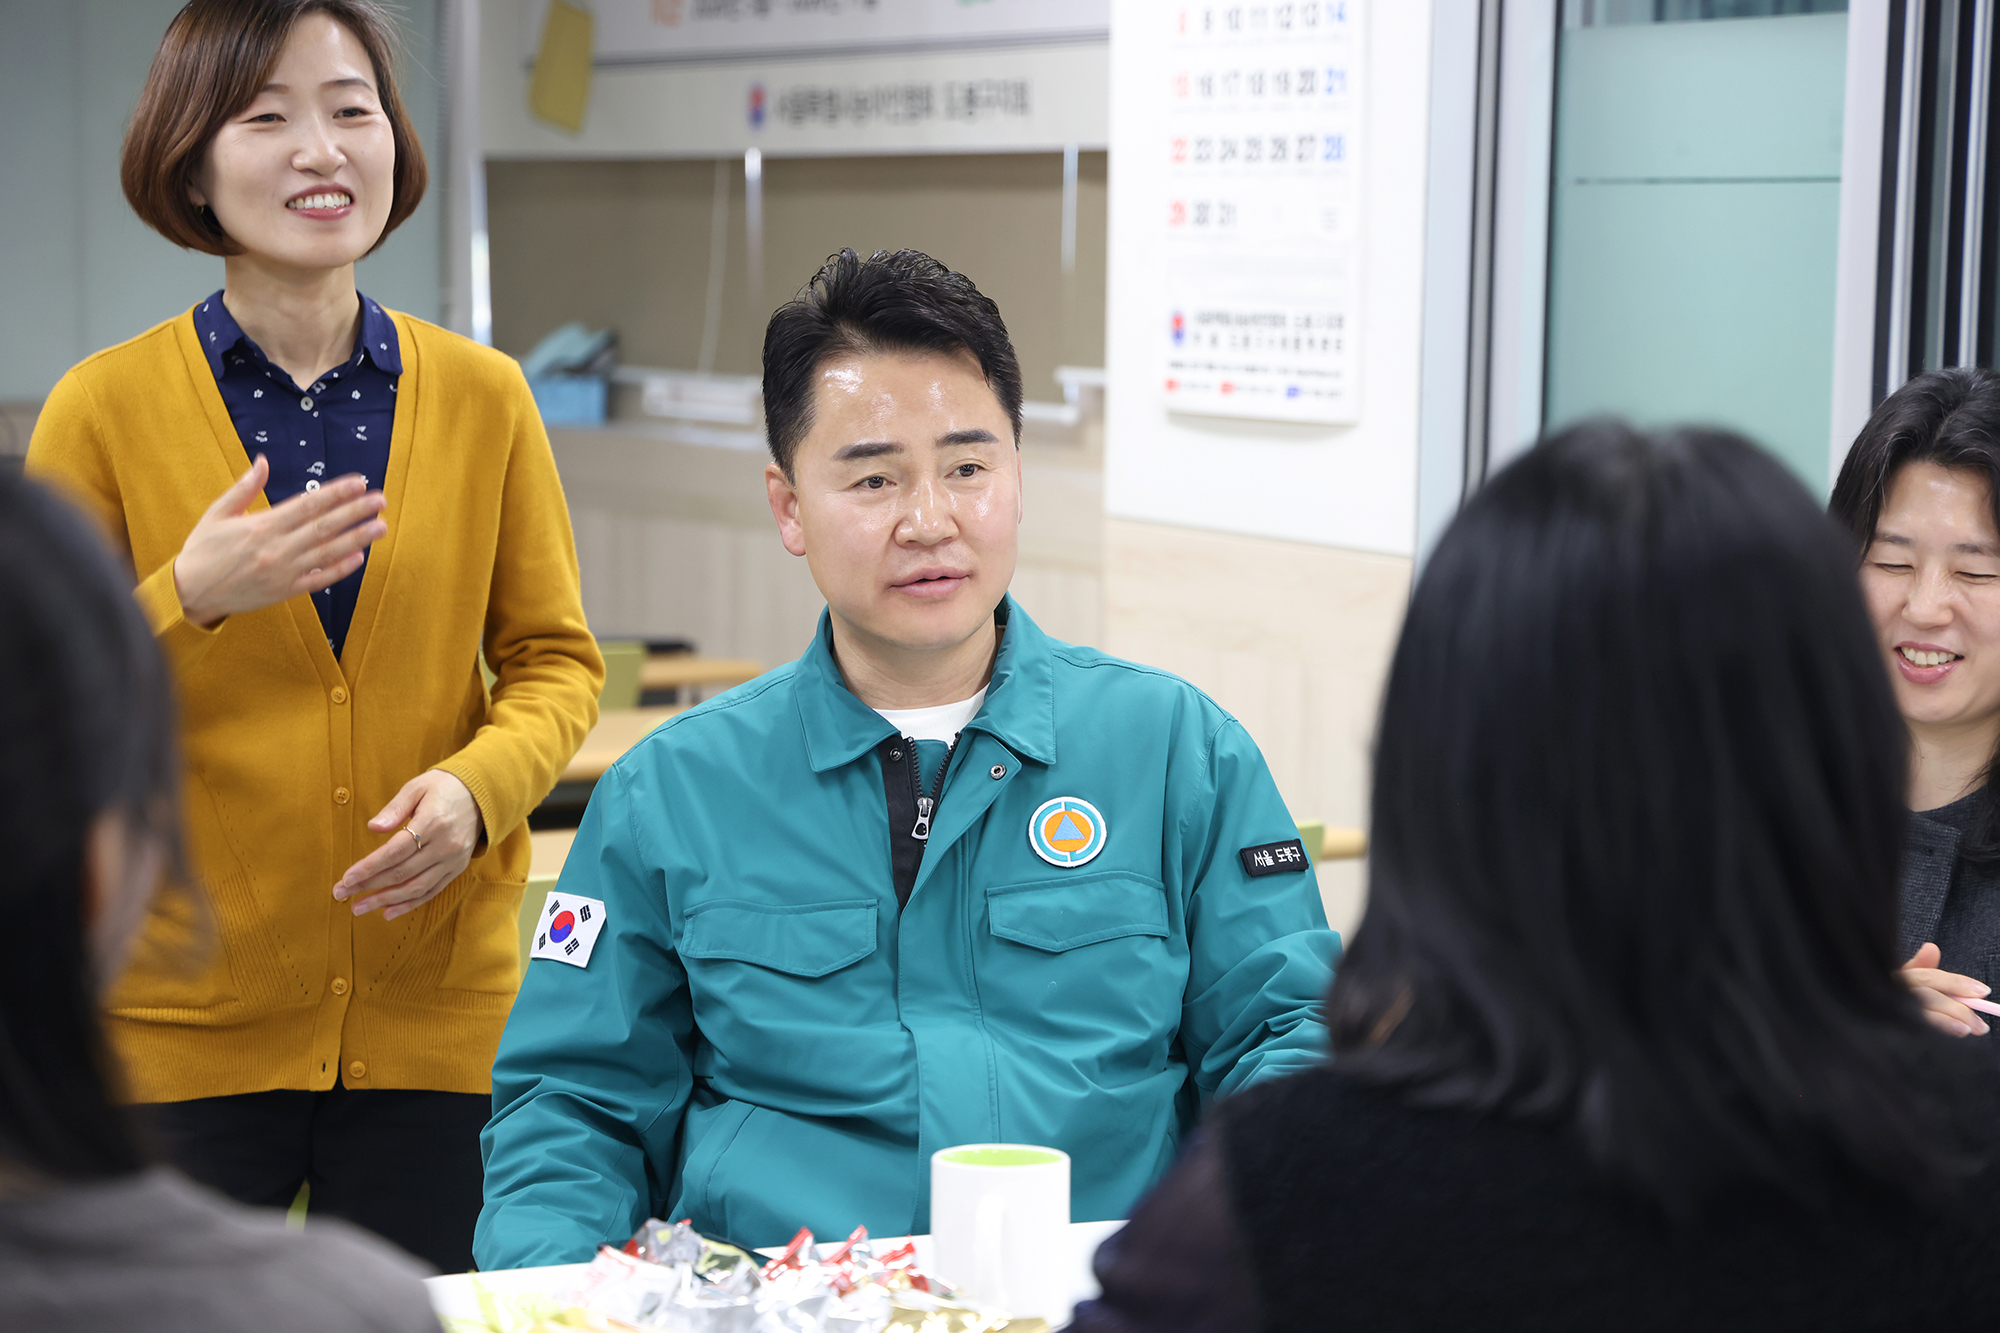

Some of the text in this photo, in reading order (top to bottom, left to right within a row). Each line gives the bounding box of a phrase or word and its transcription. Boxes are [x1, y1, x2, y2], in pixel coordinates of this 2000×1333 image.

[1276, 4, 1293, 29] 12
[1327, 2, 1346, 23] 14
[1223, 70, 1240, 96] 17
[1298, 67, 1317, 95] 20
[1325, 67, 1346, 94] 21
[1220, 136, 1238, 163] 24
[1297, 134, 1315, 162] 27
[1254, 846, 1301, 867] 서울 도봉구
